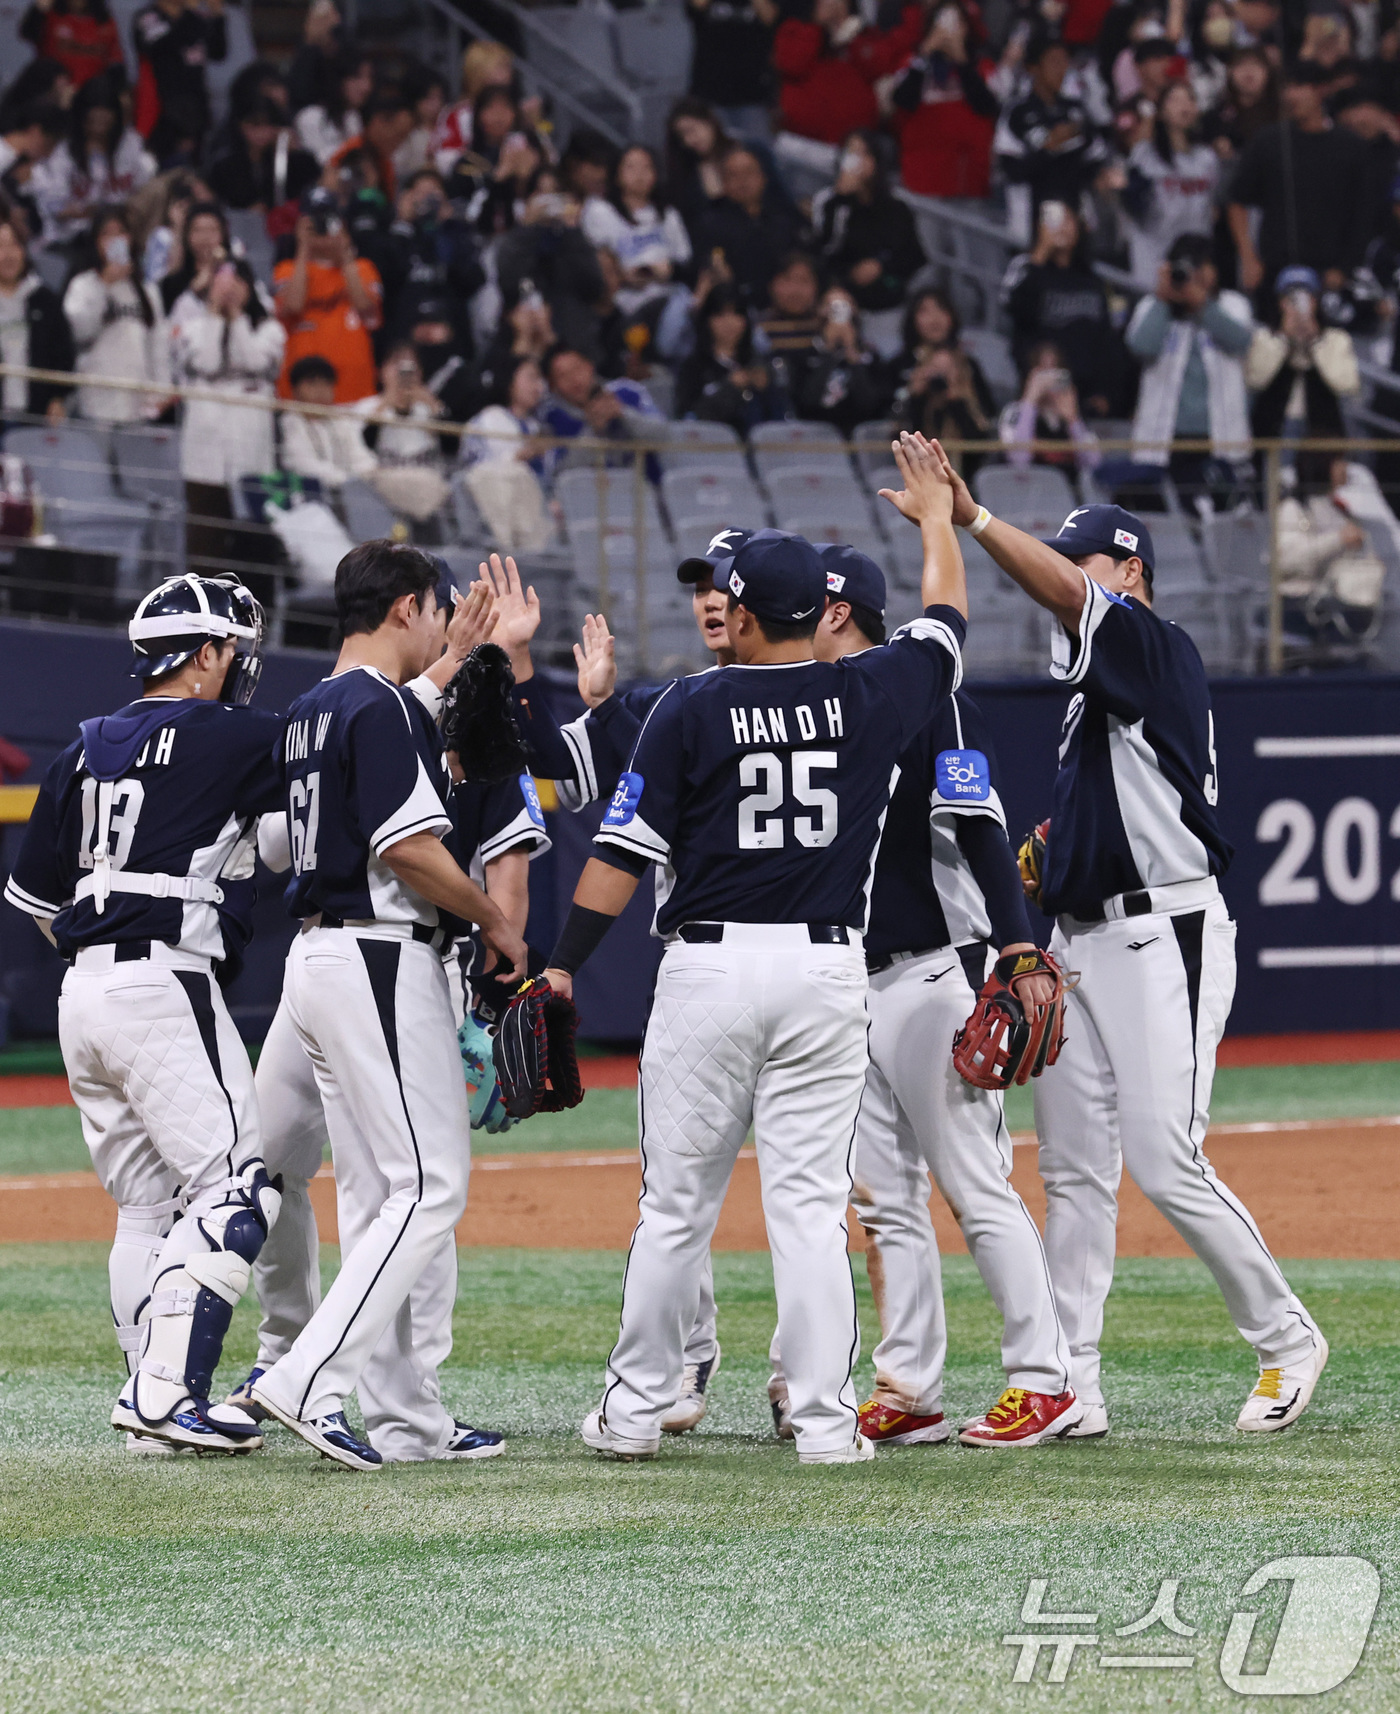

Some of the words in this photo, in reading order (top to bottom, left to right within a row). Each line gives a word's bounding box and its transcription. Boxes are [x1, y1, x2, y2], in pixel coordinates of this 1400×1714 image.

[314, 712, 333, 751] W
[729, 707, 789, 744] HAN
[795, 704, 817, 741] D
[823, 697, 844, 738] H
[154, 727, 176, 766] H
[944, 756, 961, 765] 신한
[738, 750, 839, 849] 25
[955, 783, 983, 794] Bank
[78, 776, 146, 872] 13
[289, 771, 321, 878] 67
[1256, 796, 1400, 905] 20
